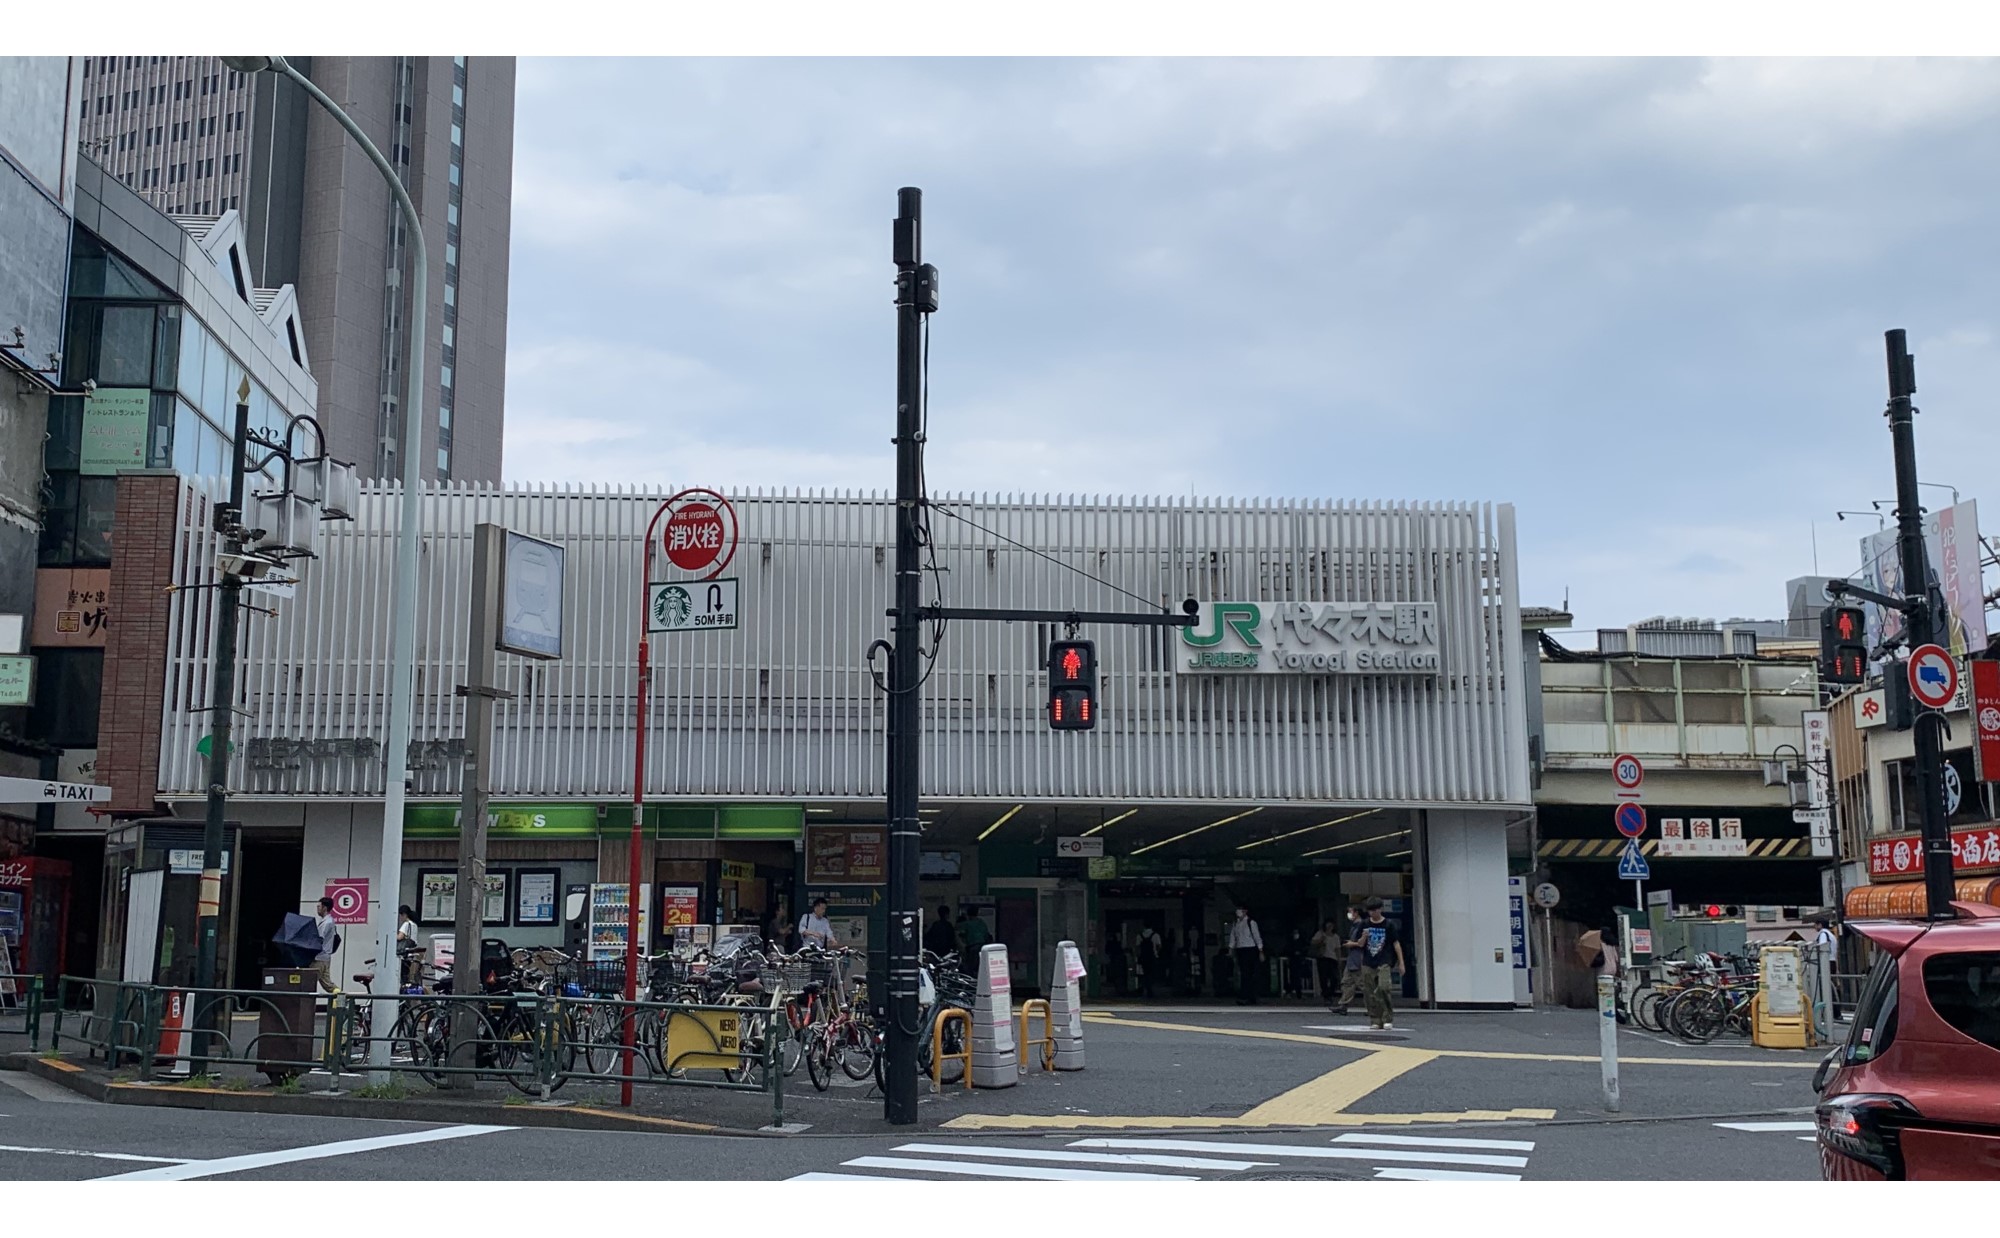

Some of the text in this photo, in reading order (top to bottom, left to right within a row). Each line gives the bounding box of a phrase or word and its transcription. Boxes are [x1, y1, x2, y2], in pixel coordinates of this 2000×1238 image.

[674, 510, 715, 520] FIRE HYDRANT
[668, 522, 721, 551] 消火栓
[1182, 603, 1262, 647] JR
[1271, 603, 1437, 646] 代々木駅
[1188, 651, 1259, 669] JR東日本
[1273, 650, 1440, 672] Yoyogi Station
[1620, 764, 1637, 779] 30
[60, 784, 93, 801] TAXI
[1664, 820, 1739, 838] 最徐行
[1872, 842, 1890, 858] 本格
[343, 897, 350, 907] E
[720, 1019, 736, 1032] NERO
[720, 1035, 737, 1049] NERO
